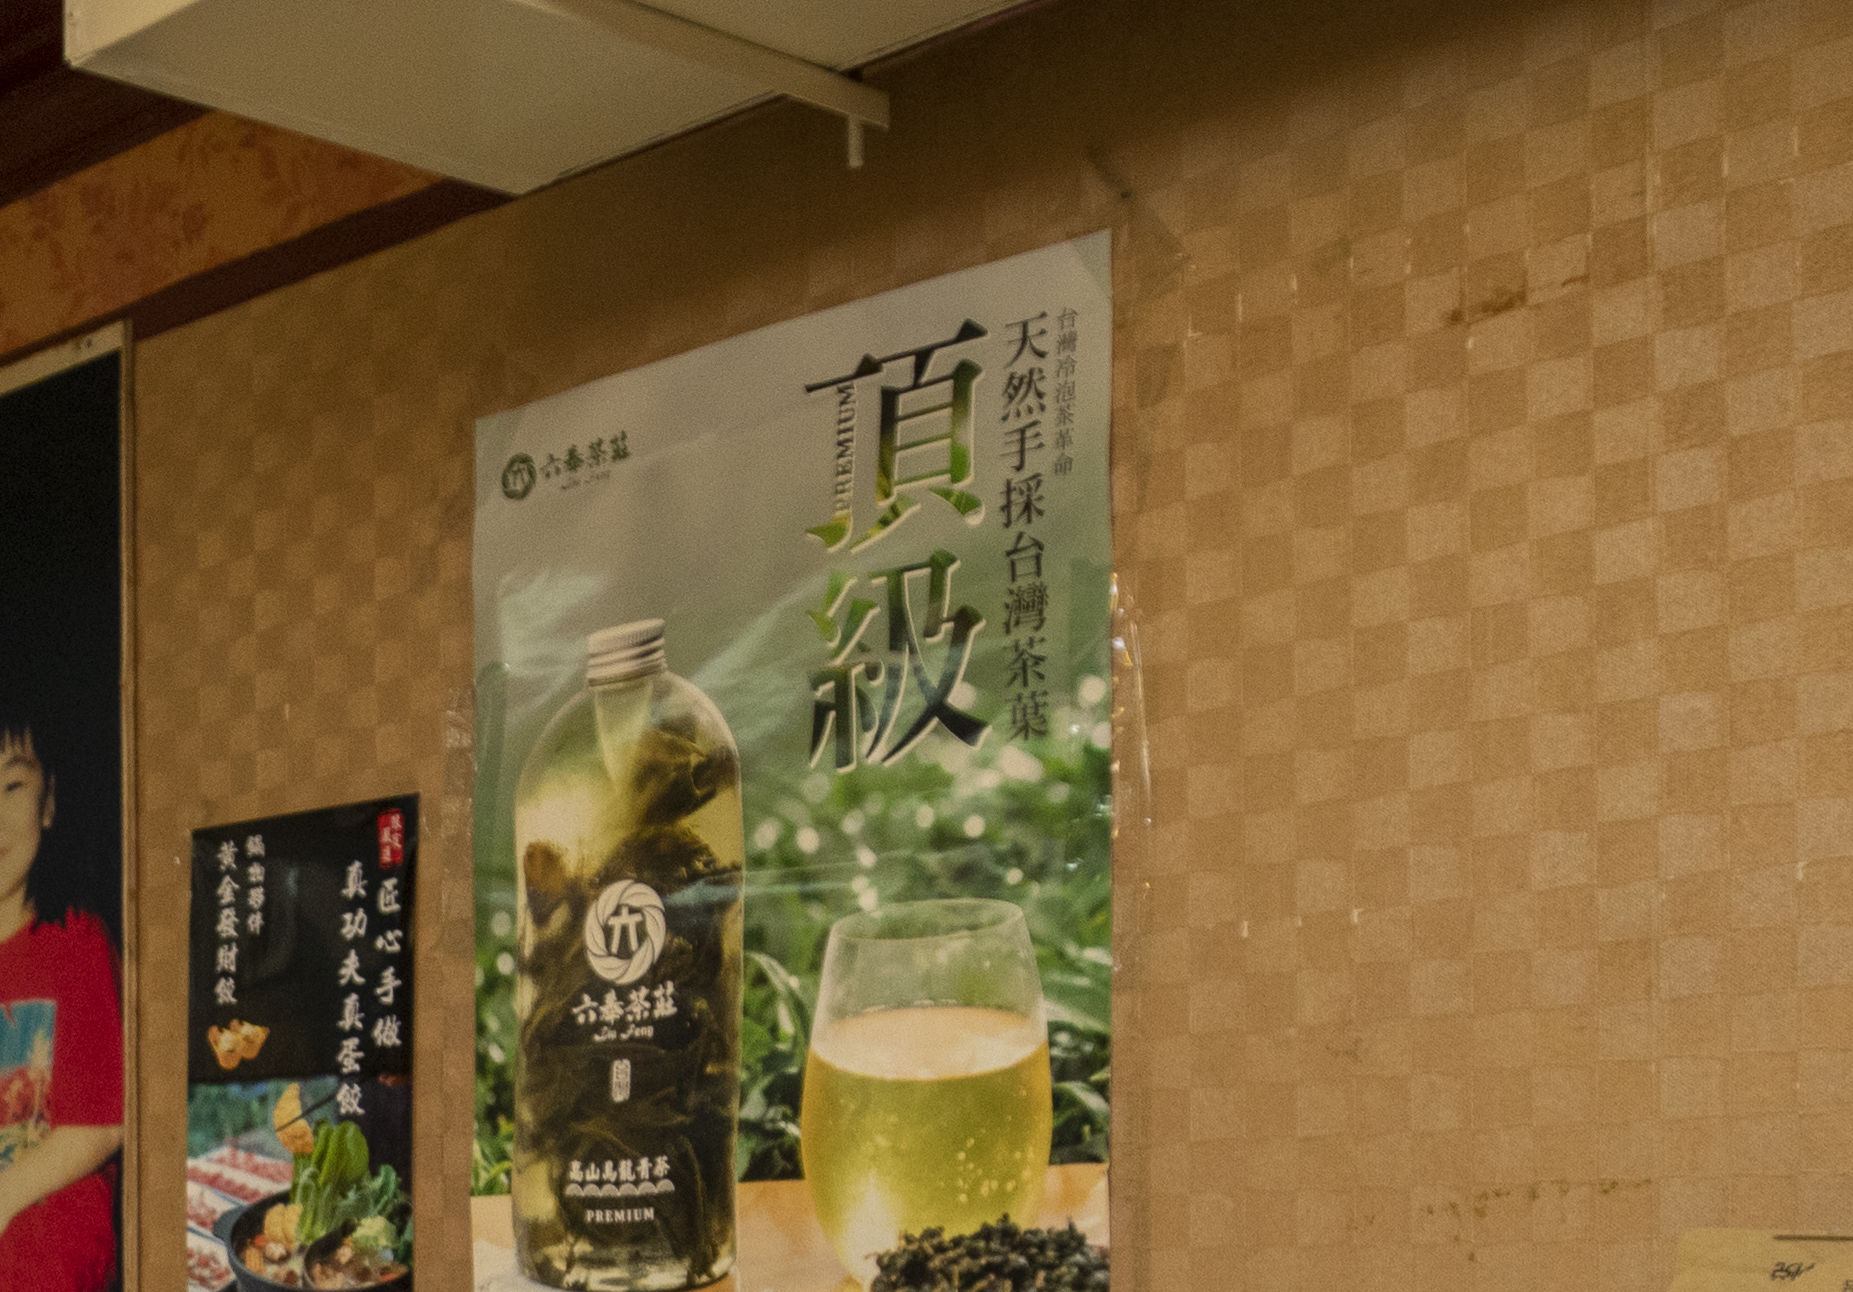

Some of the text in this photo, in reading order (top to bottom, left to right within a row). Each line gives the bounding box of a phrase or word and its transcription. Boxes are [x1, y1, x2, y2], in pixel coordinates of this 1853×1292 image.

[835, 381, 856, 514] PREMIUM
[1053, 306, 1078, 477] 台灣冷泡茶革命
[803, 317, 992, 774] 頂級
[999, 310, 1050, 743] 天然手採台灣茶葉
[337, 859, 368, 1116] 真功夫真蛋餃
[373, 877, 403, 1050] 匠心手做
[585, 1206, 654, 1223] PREMIUM
